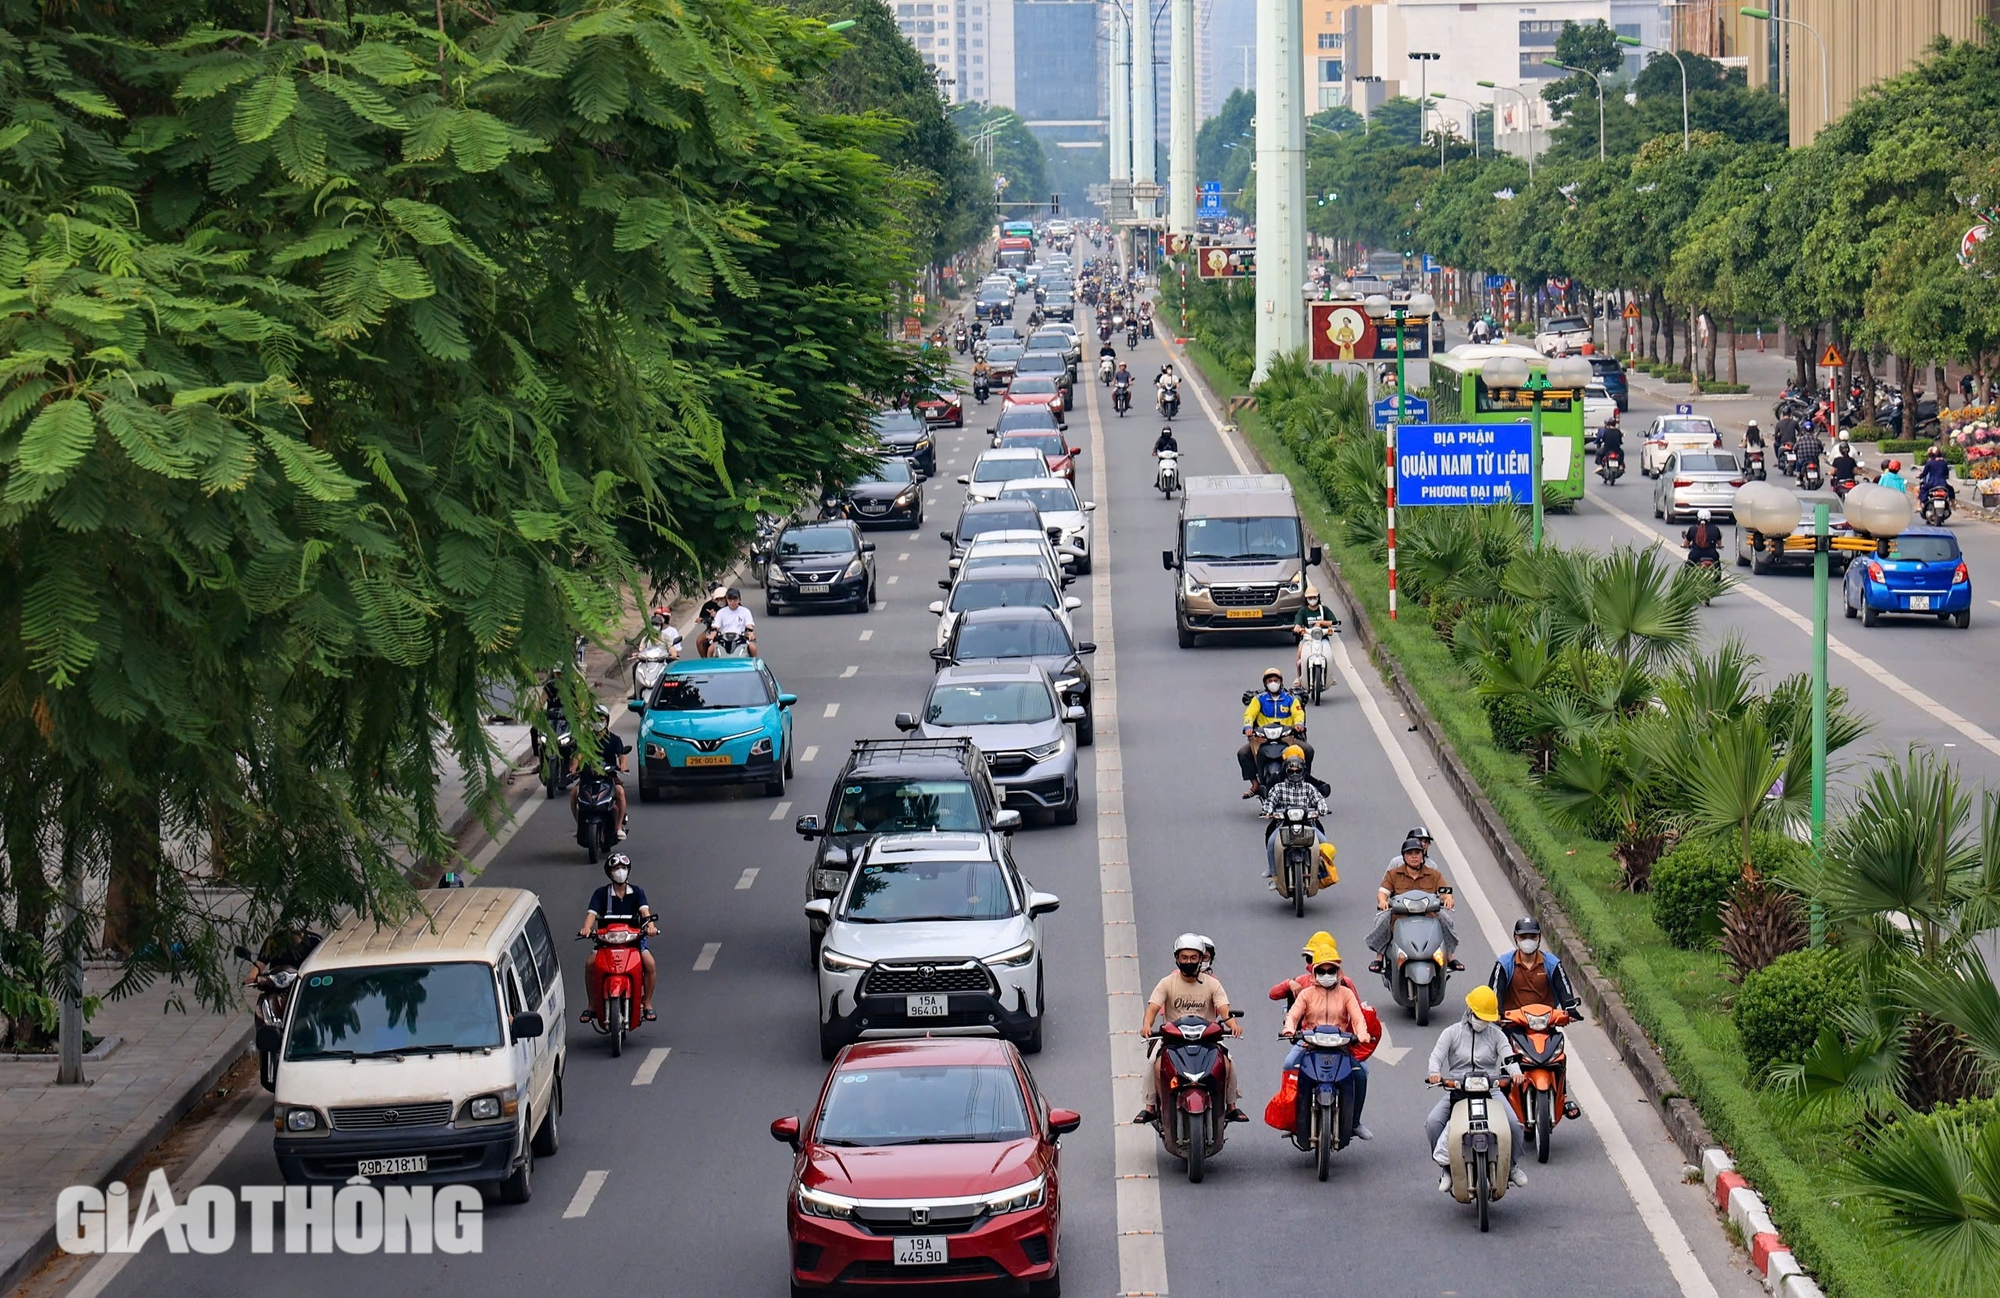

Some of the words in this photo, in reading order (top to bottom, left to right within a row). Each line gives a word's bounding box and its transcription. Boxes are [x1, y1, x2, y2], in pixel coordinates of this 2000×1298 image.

[1433, 432, 1455, 447] ĐỊA
[1459, 429, 1494, 446] PHẬN
[1401, 451, 1437, 480] QUẬN
[1441, 454, 1472, 475] NAM
[1476, 450, 1494, 475] TỪ
[1497, 449, 1529, 475] LIÊM
[1470, 485, 1490, 500] ĐẠI
[1493, 481, 1512, 498] MỖ
[920, 996, 936, 1005] 15A
[1174, 997, 1206, 1010] Original
[911, 1005, 943, 1015] 964.01
[910, 1238, 932, 1250] 19A
[900, 1251, 942, 1263] 445.90
